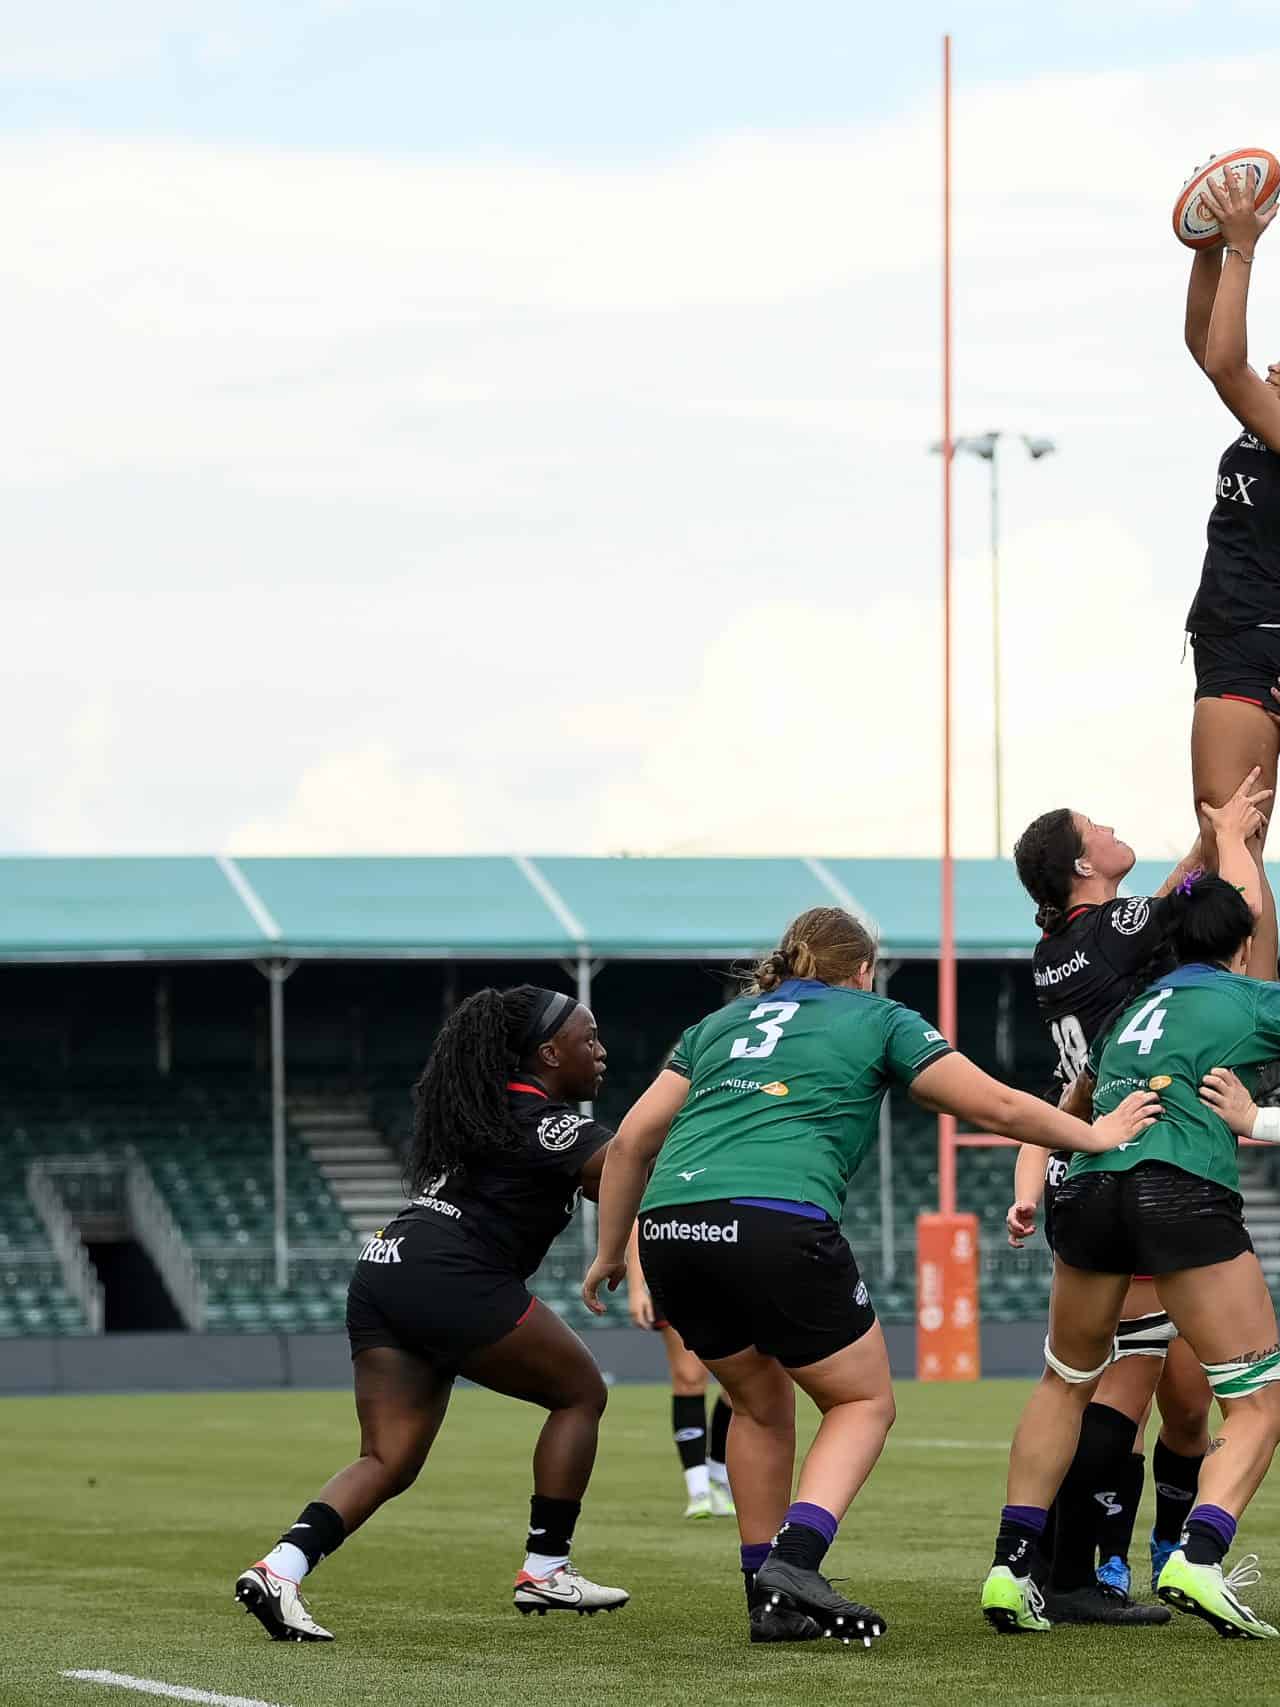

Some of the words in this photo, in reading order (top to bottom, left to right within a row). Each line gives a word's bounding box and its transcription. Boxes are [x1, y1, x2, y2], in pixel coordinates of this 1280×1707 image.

[730, 1002, 800, 1059] 3
[1117, 988, 1173, 1055] 4
[642, 1218, 739, 1243] Contested
